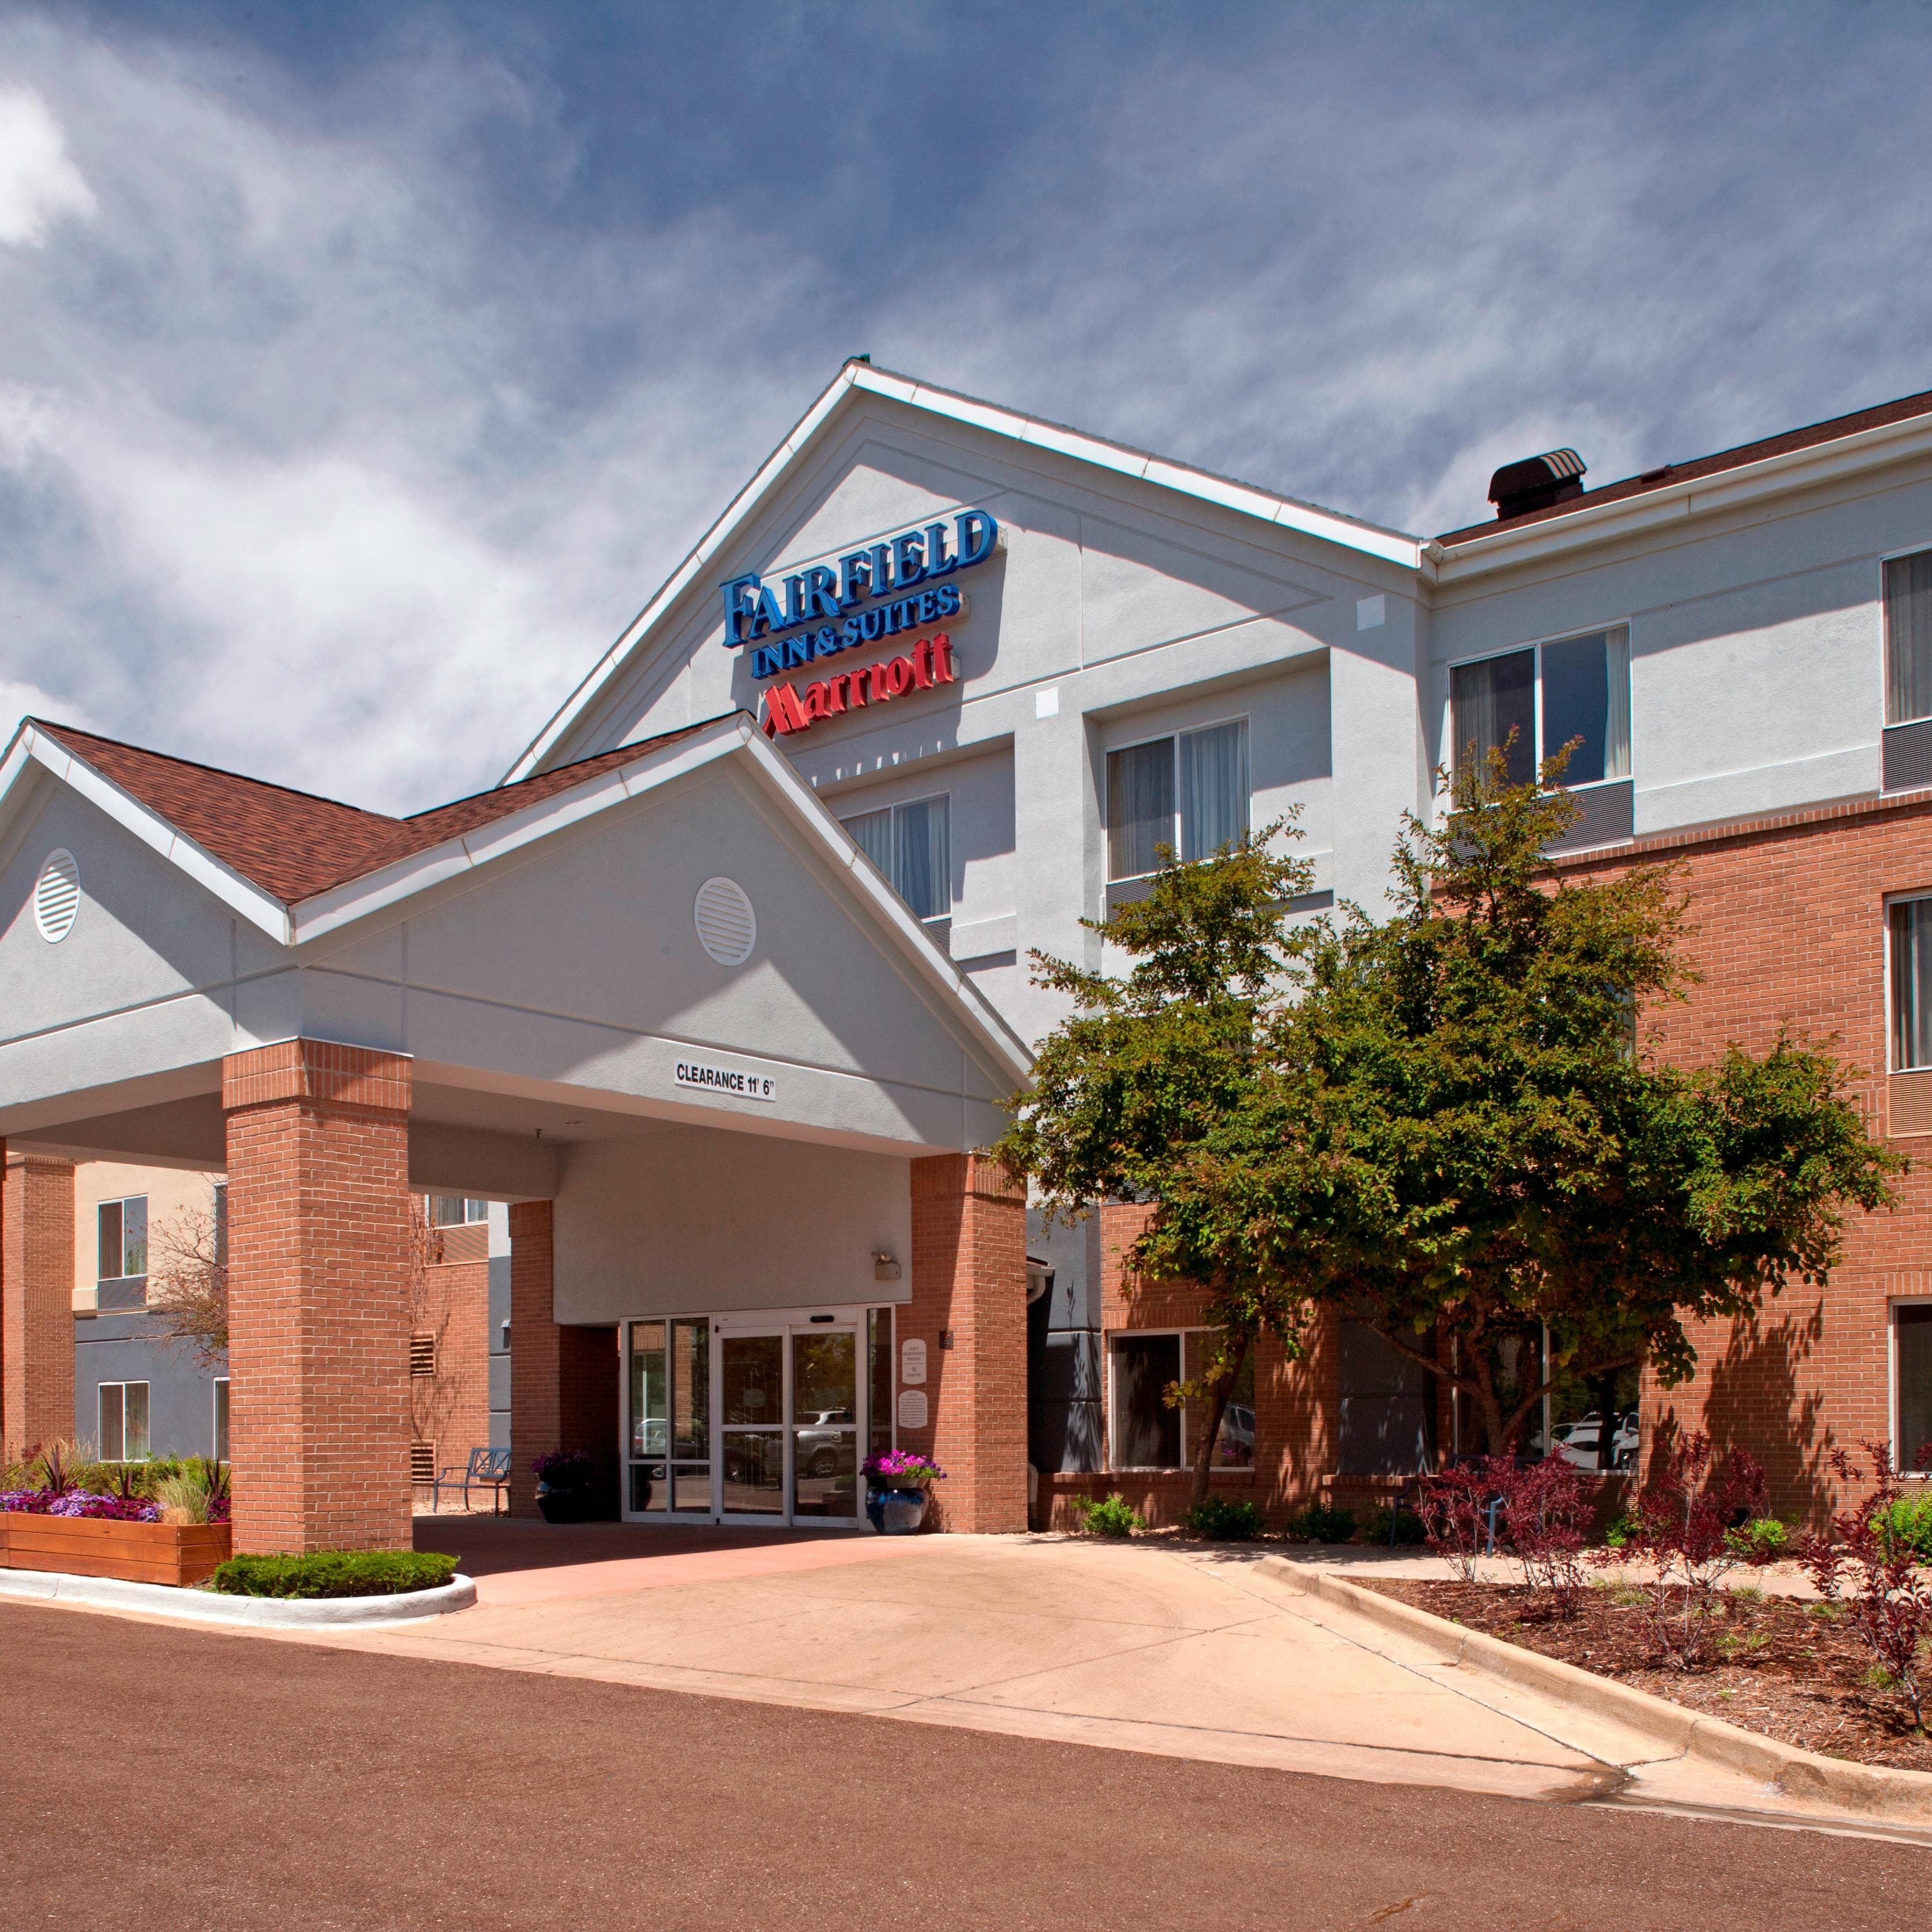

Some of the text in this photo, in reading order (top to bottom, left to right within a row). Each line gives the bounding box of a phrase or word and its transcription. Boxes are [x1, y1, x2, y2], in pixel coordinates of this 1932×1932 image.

[719, 509, 999, 649] FAIRFIELD
[761, 632, 954, 740] Marriott
[676, 1063, 744, 1091] CLEARANCE
